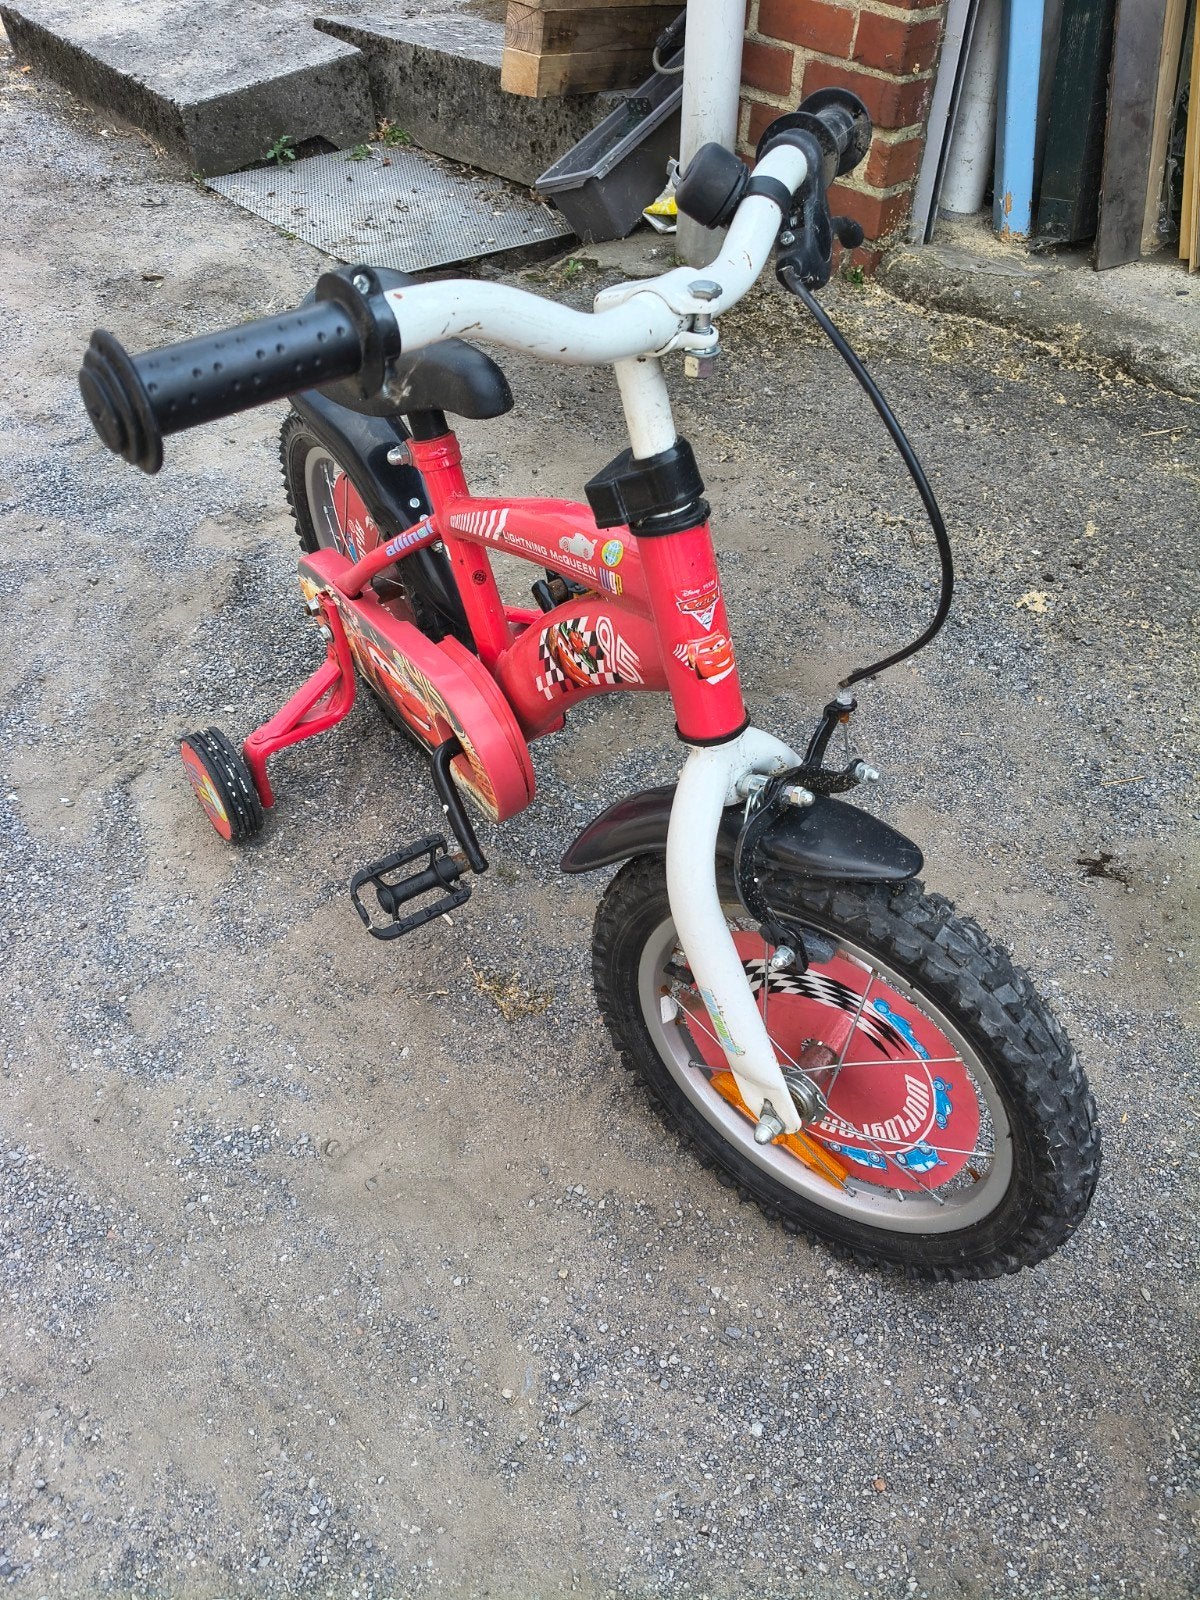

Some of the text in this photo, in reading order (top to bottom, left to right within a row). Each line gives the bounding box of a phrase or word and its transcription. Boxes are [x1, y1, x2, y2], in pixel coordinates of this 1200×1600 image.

[502, 530, 597, 577] LIGHTNING McQUEEN
[596, 616, 646, 684] 95
